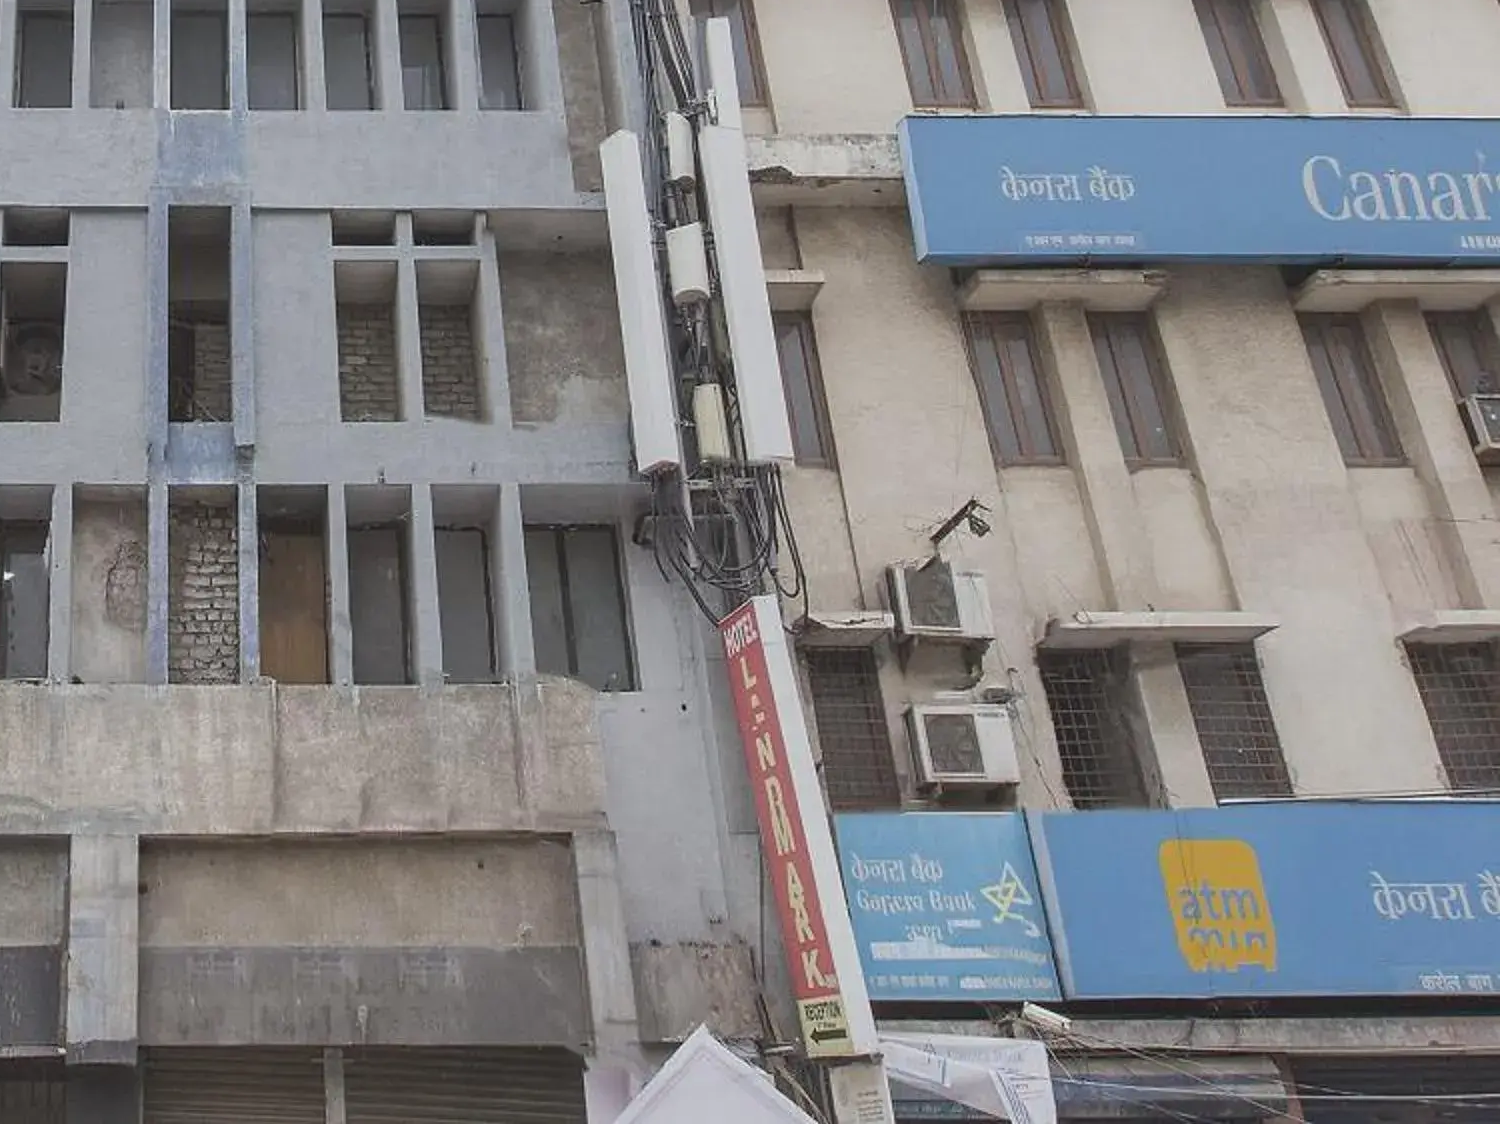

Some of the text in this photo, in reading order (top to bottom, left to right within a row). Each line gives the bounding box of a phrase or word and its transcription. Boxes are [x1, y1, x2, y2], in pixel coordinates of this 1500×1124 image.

[1302, 154, 1500, 222] Canar
[1179, 881, 1260, 920] atm
[1369, 870, 1476, 920] केनरा
